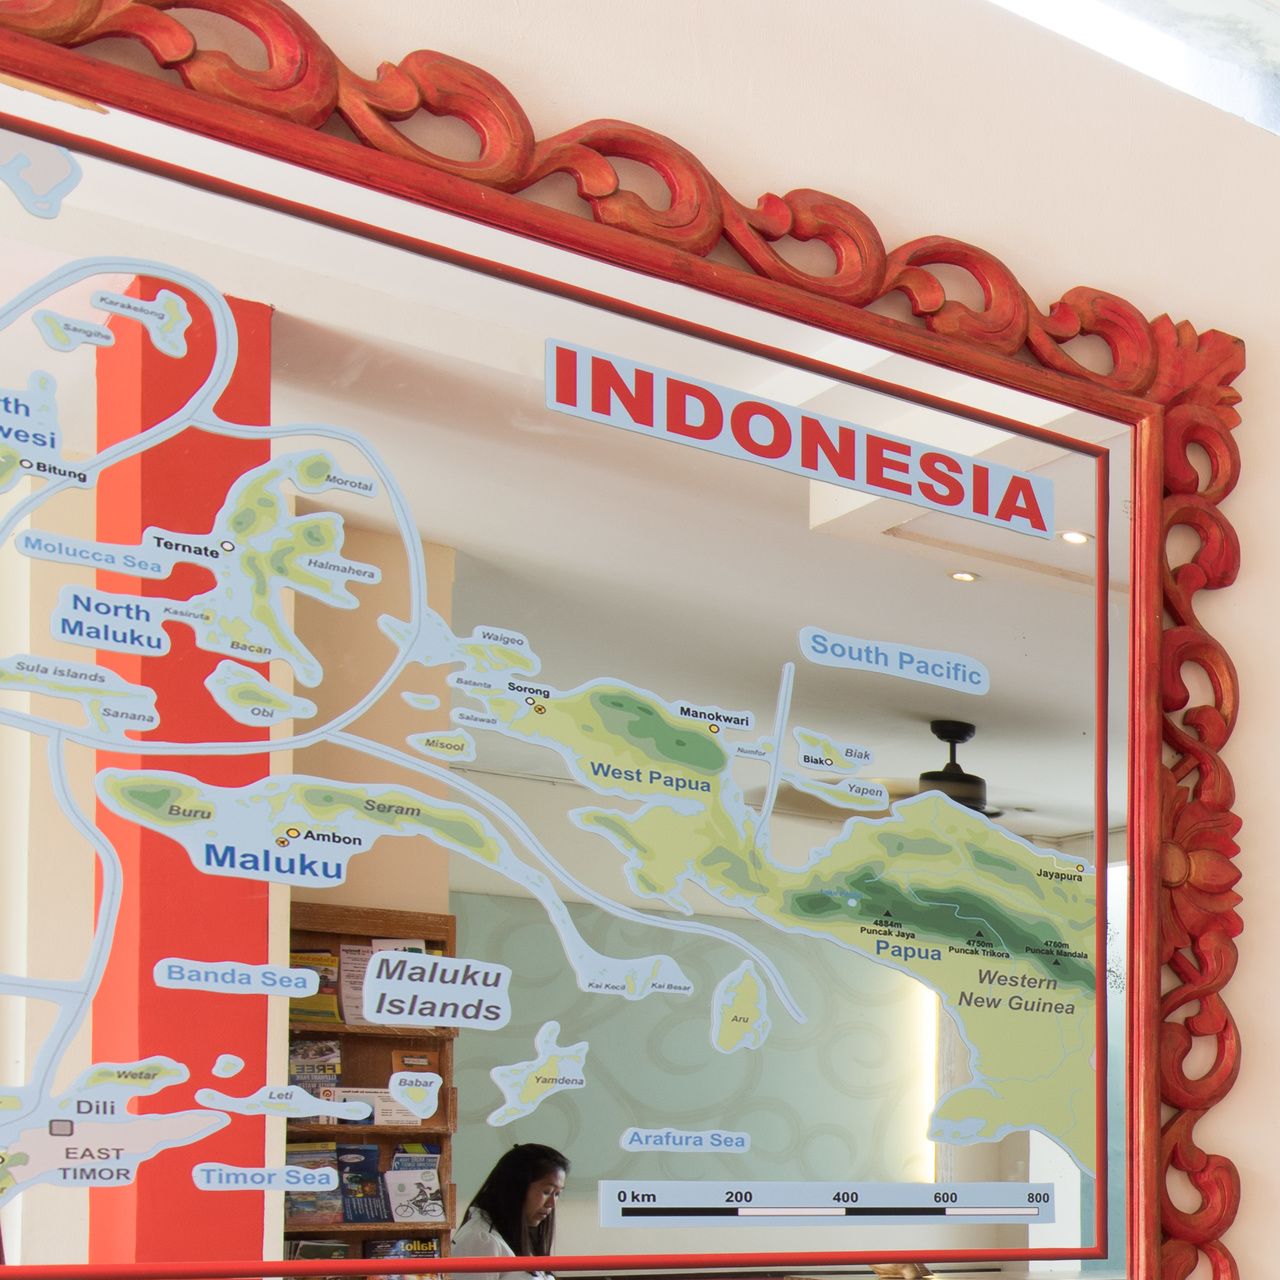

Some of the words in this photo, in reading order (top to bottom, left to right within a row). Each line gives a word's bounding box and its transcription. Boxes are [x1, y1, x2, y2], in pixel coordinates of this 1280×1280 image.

[99, 296, 165, 320] Karakelong
[63, 322, 112, 341] Sangihe
[1, 397, 30, 417] th
[555, 346, 1048, 532] INDONESIA
[36, 462, 87, 482] Bitung
[325, 473, 373, 492] Morotai
[24, 536, 116, 565] Molucca
[123, 555, 162, 573] Sea
[153, 535, 220, 559] Ternate
[308, 558, 375, 579] Halmahera
[72, 593, 151, 623] North
[163, 606, 210, 621] Kasiruta
[61, 617, 162, 650] Maluku
[482, 630, 524, 647] Waigeo
[230, 640, 272, 655] Bacan
[810, 634, 889, 667] South
[899, 651, 982, 685] Pacific
[15, 661, 49, 675] Sula
[52, 664, 106, 684] islands
[456, 677, 492, 689] Batanta
[507, 682, 550, 699] Sorong
[102, 707, 155, 723] Sanana
[251, 706, 274, 719] Obi
[458, 712, 497, 725] Salawati
[679, 706, 749, 727] Manokwari
[425, 738, 464, 752] Misool
[803, 754, 824, 766] Biak
[845, 748, 870, 761] Biak
[590, 761, 642, 784] West
[649, 771, 711, 793] Papua
[848, 783, 883, 799] Yapen
[168, 804, 212, 820] Buru
[363, 799, 421, 817] Seram
[304, 830, 362, 847] Ambon
[204, 843, 343, 880] Maluku
[1037, 869, 1083, 882] Jayapura
[860, 927, 893, 937] Puncak
[895, 931, 915, 940] Jaya
[875, 940, 942, 961] Papua
[949, 946, 981, 957] Puncak
[984, 949, 1010, 959] Trikora
[1025, 946, 1055, 956] Puncak
[1057, 949, 1088, 960] Mandala
[167, 964, 251, 986] Banda
[260, 971, 308, 990] Sea
[376, 958, 502, 988] Maluku
[977, 969, 1058, 990] Western
[588, 981, 602, 990] Kai
[651, 982, 665, 990] Kai
[667, 983, 691, 992] Besar
[376, 992, 501, 1021] Islands
[958, 991, 1002, 1010] New
[1008, 995, 1076, 1015] Guinea
[731, 1015, 749, 1024] Aru
[116, 1069, 158, 1081] Wetar
[399, 1078, 435, 1088] Babar
[534, 1076, 584, 1087] Yamdena
[269, 1090, 293, 1101] Leti
[76, 1099, 115, 1116] Dili
[629, 1132, 703, 1147] Arafura
[710, 1134, 745, 1147] Sea
[65, 1147, 124, 1161] EAST
[58, 1167, 130, 1181] TIMOR
[200, 1168, 281, 1185] Timor
[286, 1169, 331, 1185] Sea
[617, 1191, 627, 1203] 0
[631, 1190, 656, 1203] km
[725, 1190, 752, 1203] 200
[832, 1191, 859, 1203] 400
[933, 1192, 958, 1203] 600
[1027, 1192, 1050, 1203] 800
